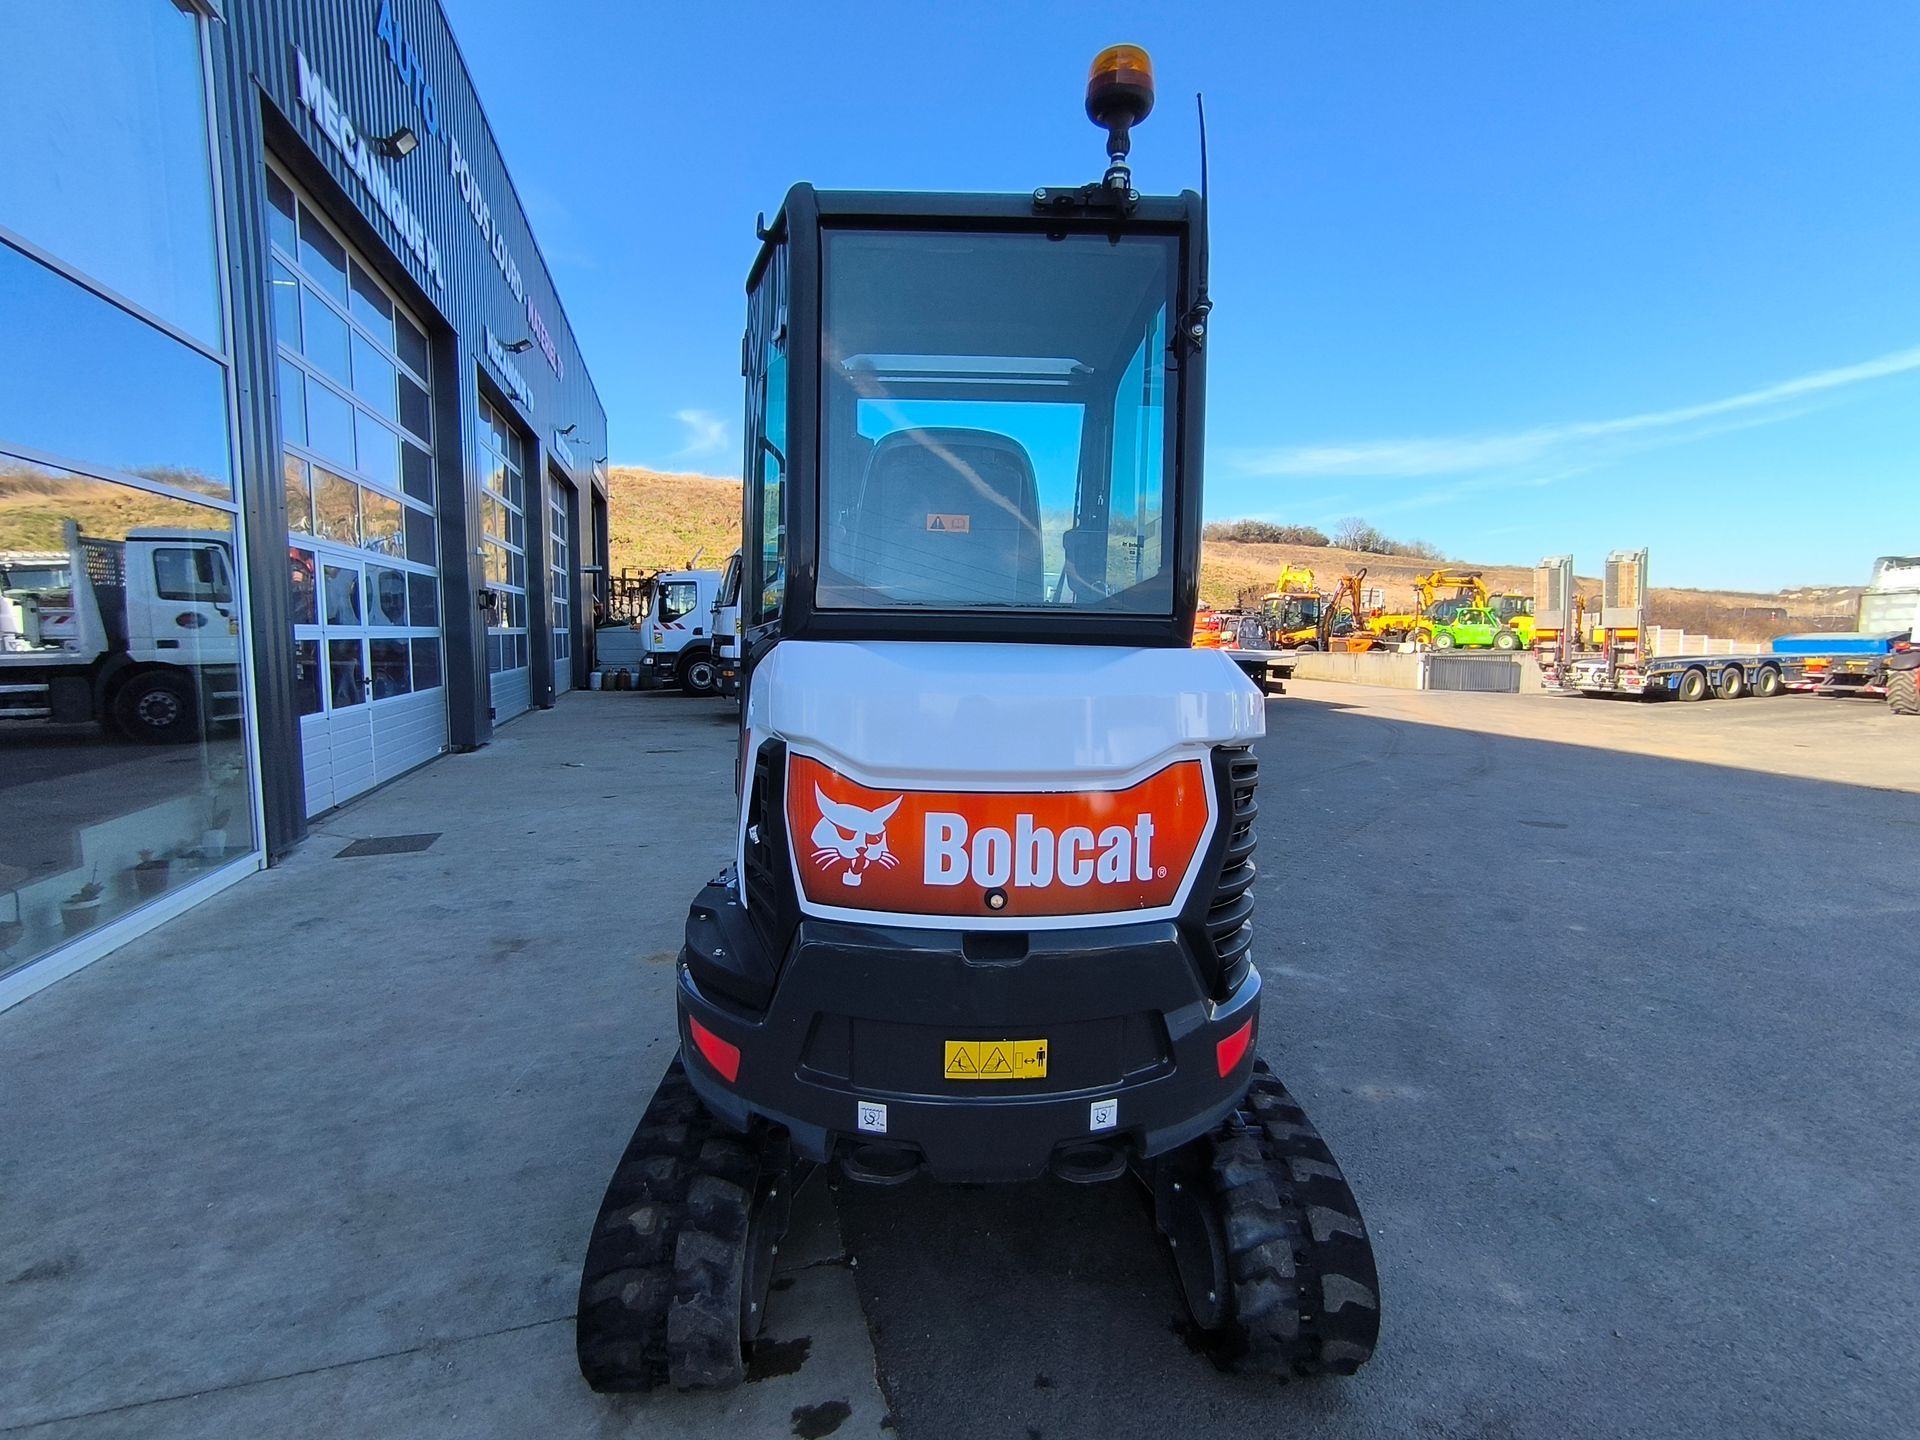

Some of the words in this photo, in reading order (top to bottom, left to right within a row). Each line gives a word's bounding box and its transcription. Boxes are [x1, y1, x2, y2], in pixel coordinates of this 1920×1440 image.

[297, 48, 426, 268] MECANIQUE
[378, 0, 439, 138] AUTO
[451, 134, 490, 242] POIDS
[492, 219, 523, 303] LOURD
[923, 812, 1154, 888] Bobcat
